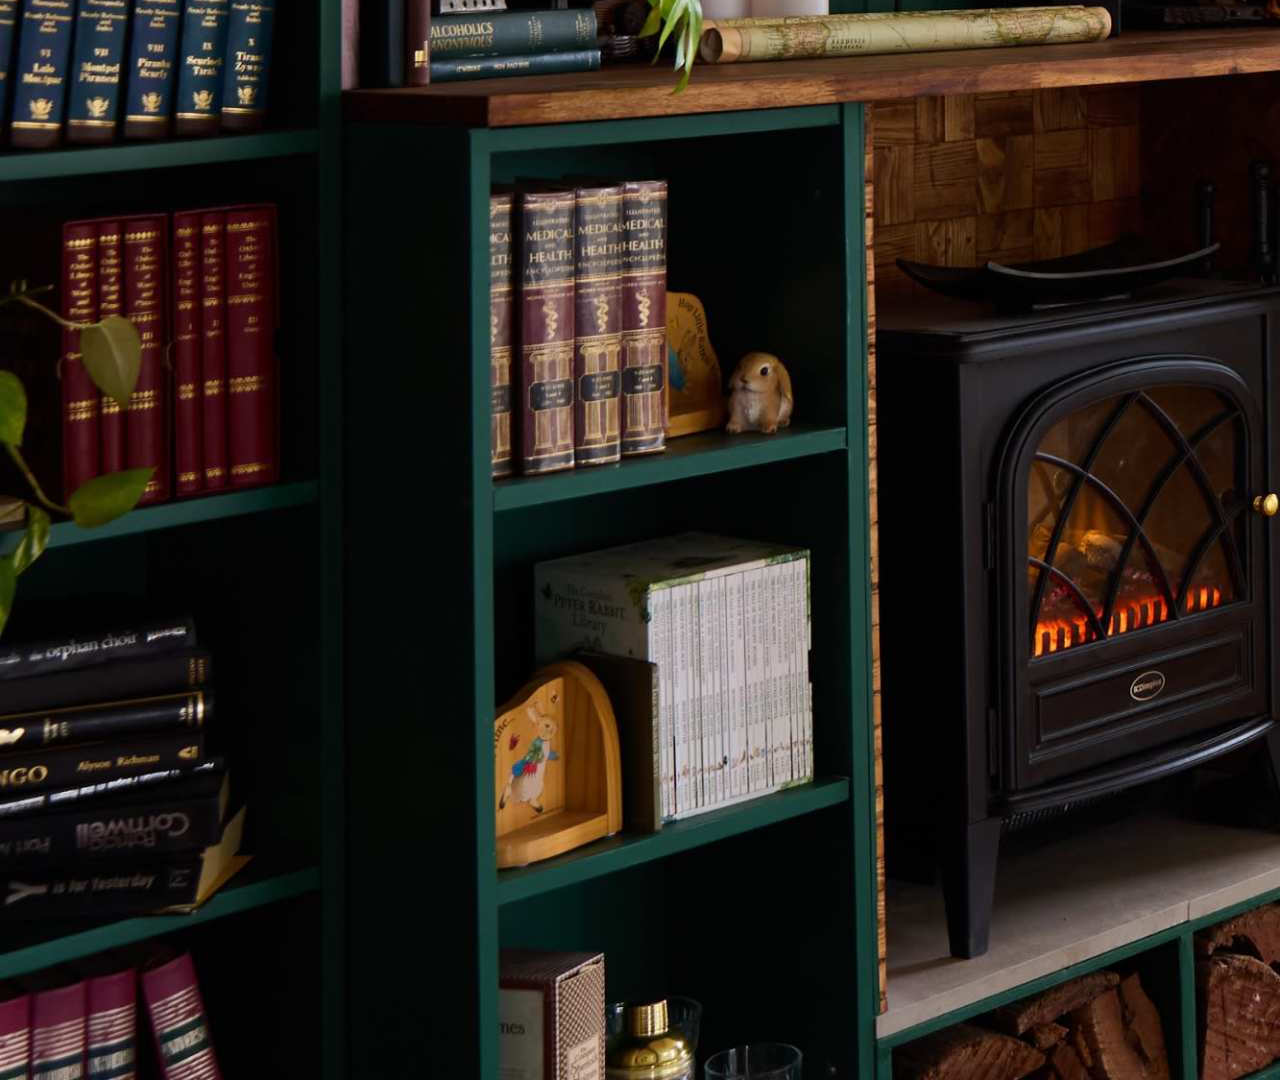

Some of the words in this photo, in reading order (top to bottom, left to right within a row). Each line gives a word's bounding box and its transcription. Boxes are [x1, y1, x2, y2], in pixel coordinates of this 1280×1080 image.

[430, 21, 494, 37] ALCOHOLICS
[578, 222, 623, 236] MEDICAL
[621, 217, 667, 232] MEDICAL
[526, 228, 574, 242] MEDICAL
[581, 243, 623, 257] HEALTH
[621, 239, 664, 253] HEALTH
[529, 249, 573, 264] HEALTH
[45, 637, 100, 661] orphan
[100, 632, 138, 651] choir
[115, 754, 161, 767] Richman
[75, 811, 190, 848] Cornwell
[91, 871, 157, 892] Yesterday
